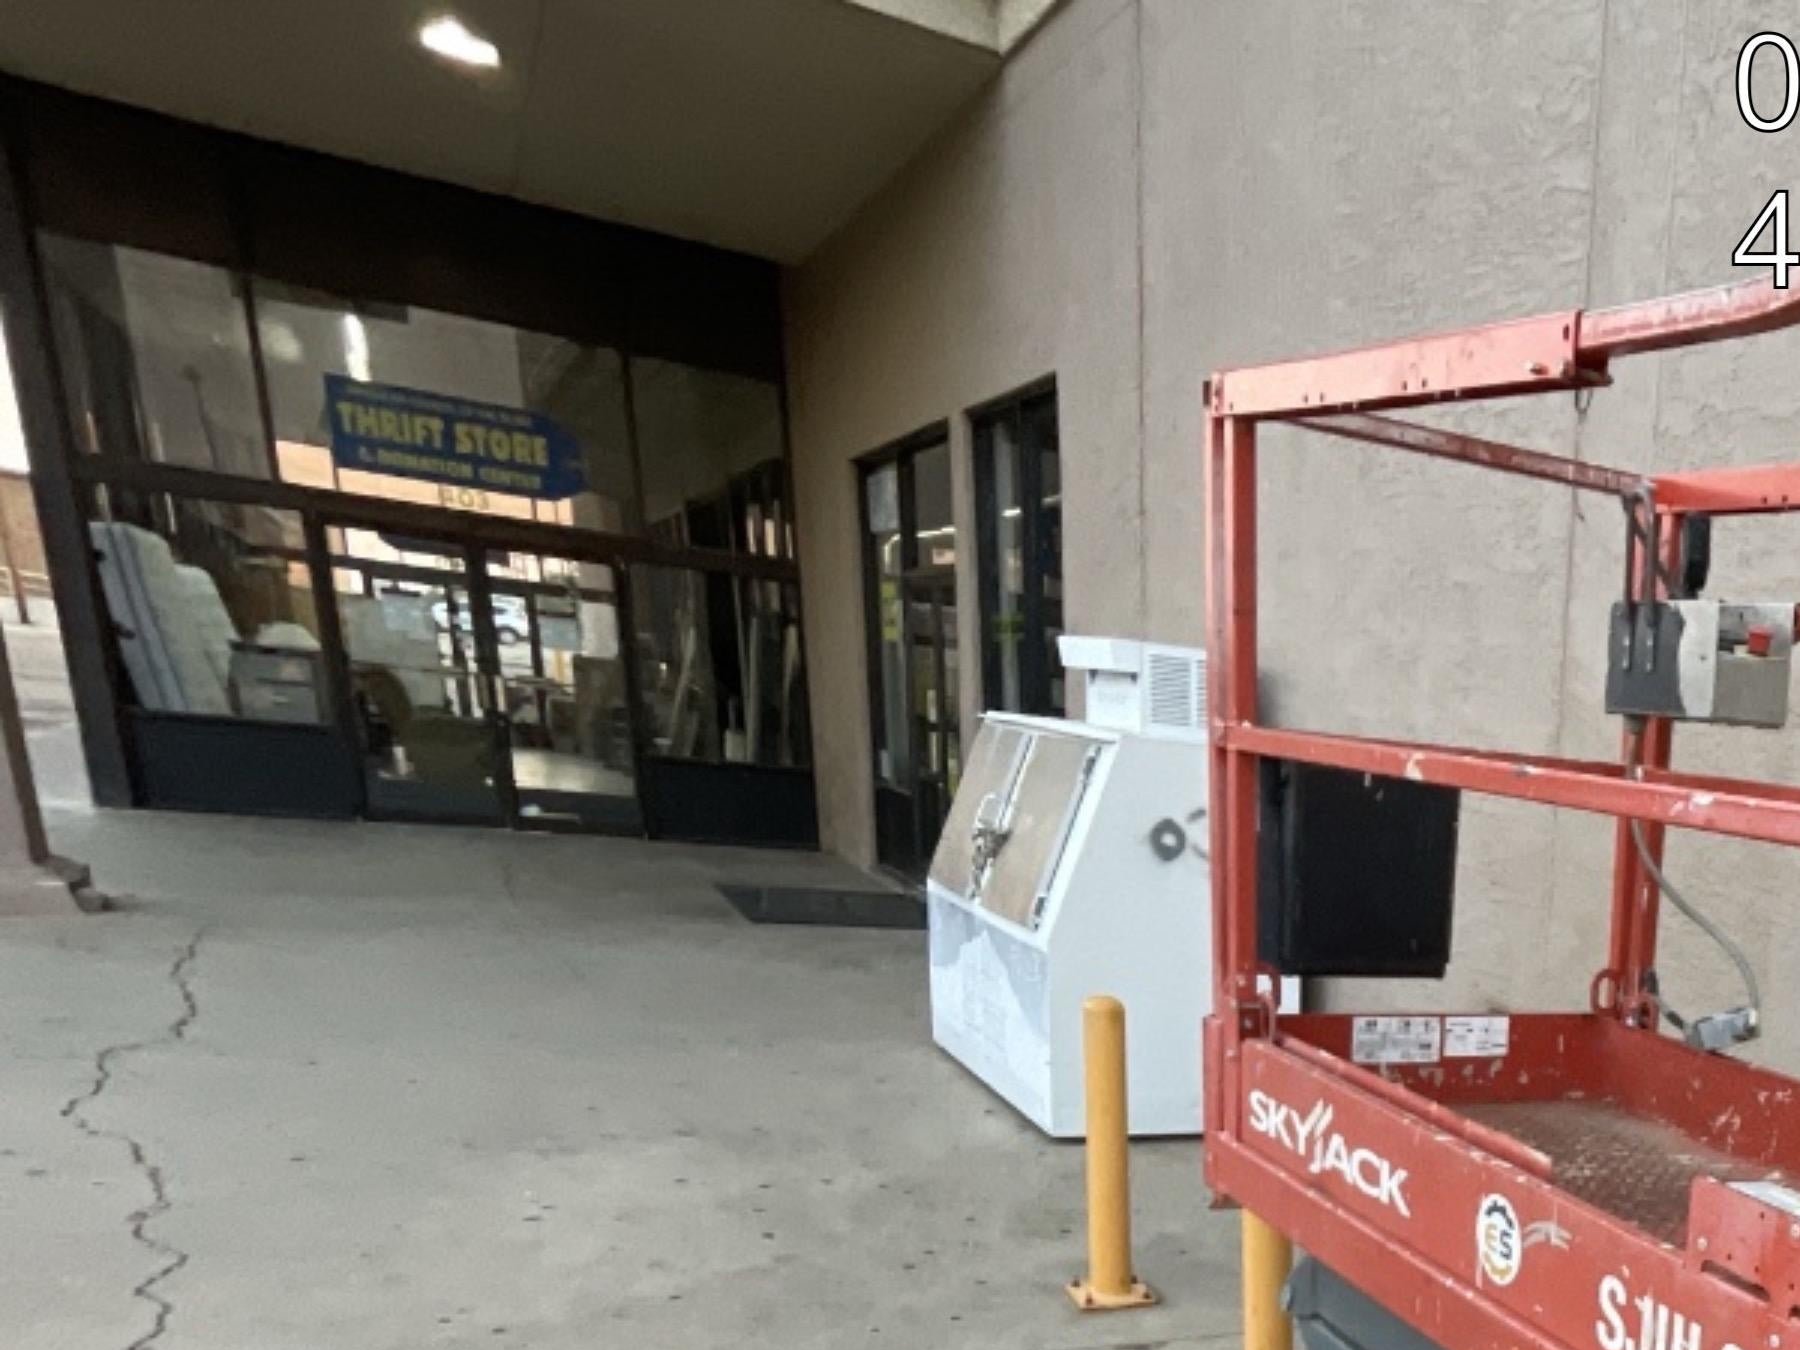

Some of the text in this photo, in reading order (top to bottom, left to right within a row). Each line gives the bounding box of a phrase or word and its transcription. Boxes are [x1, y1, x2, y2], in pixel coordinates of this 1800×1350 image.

[336, 401, 445, 449] THRIFT
[454, 421, 548, 467] STORE
[1248, 1088, 1411, 1219] SKYJACK
